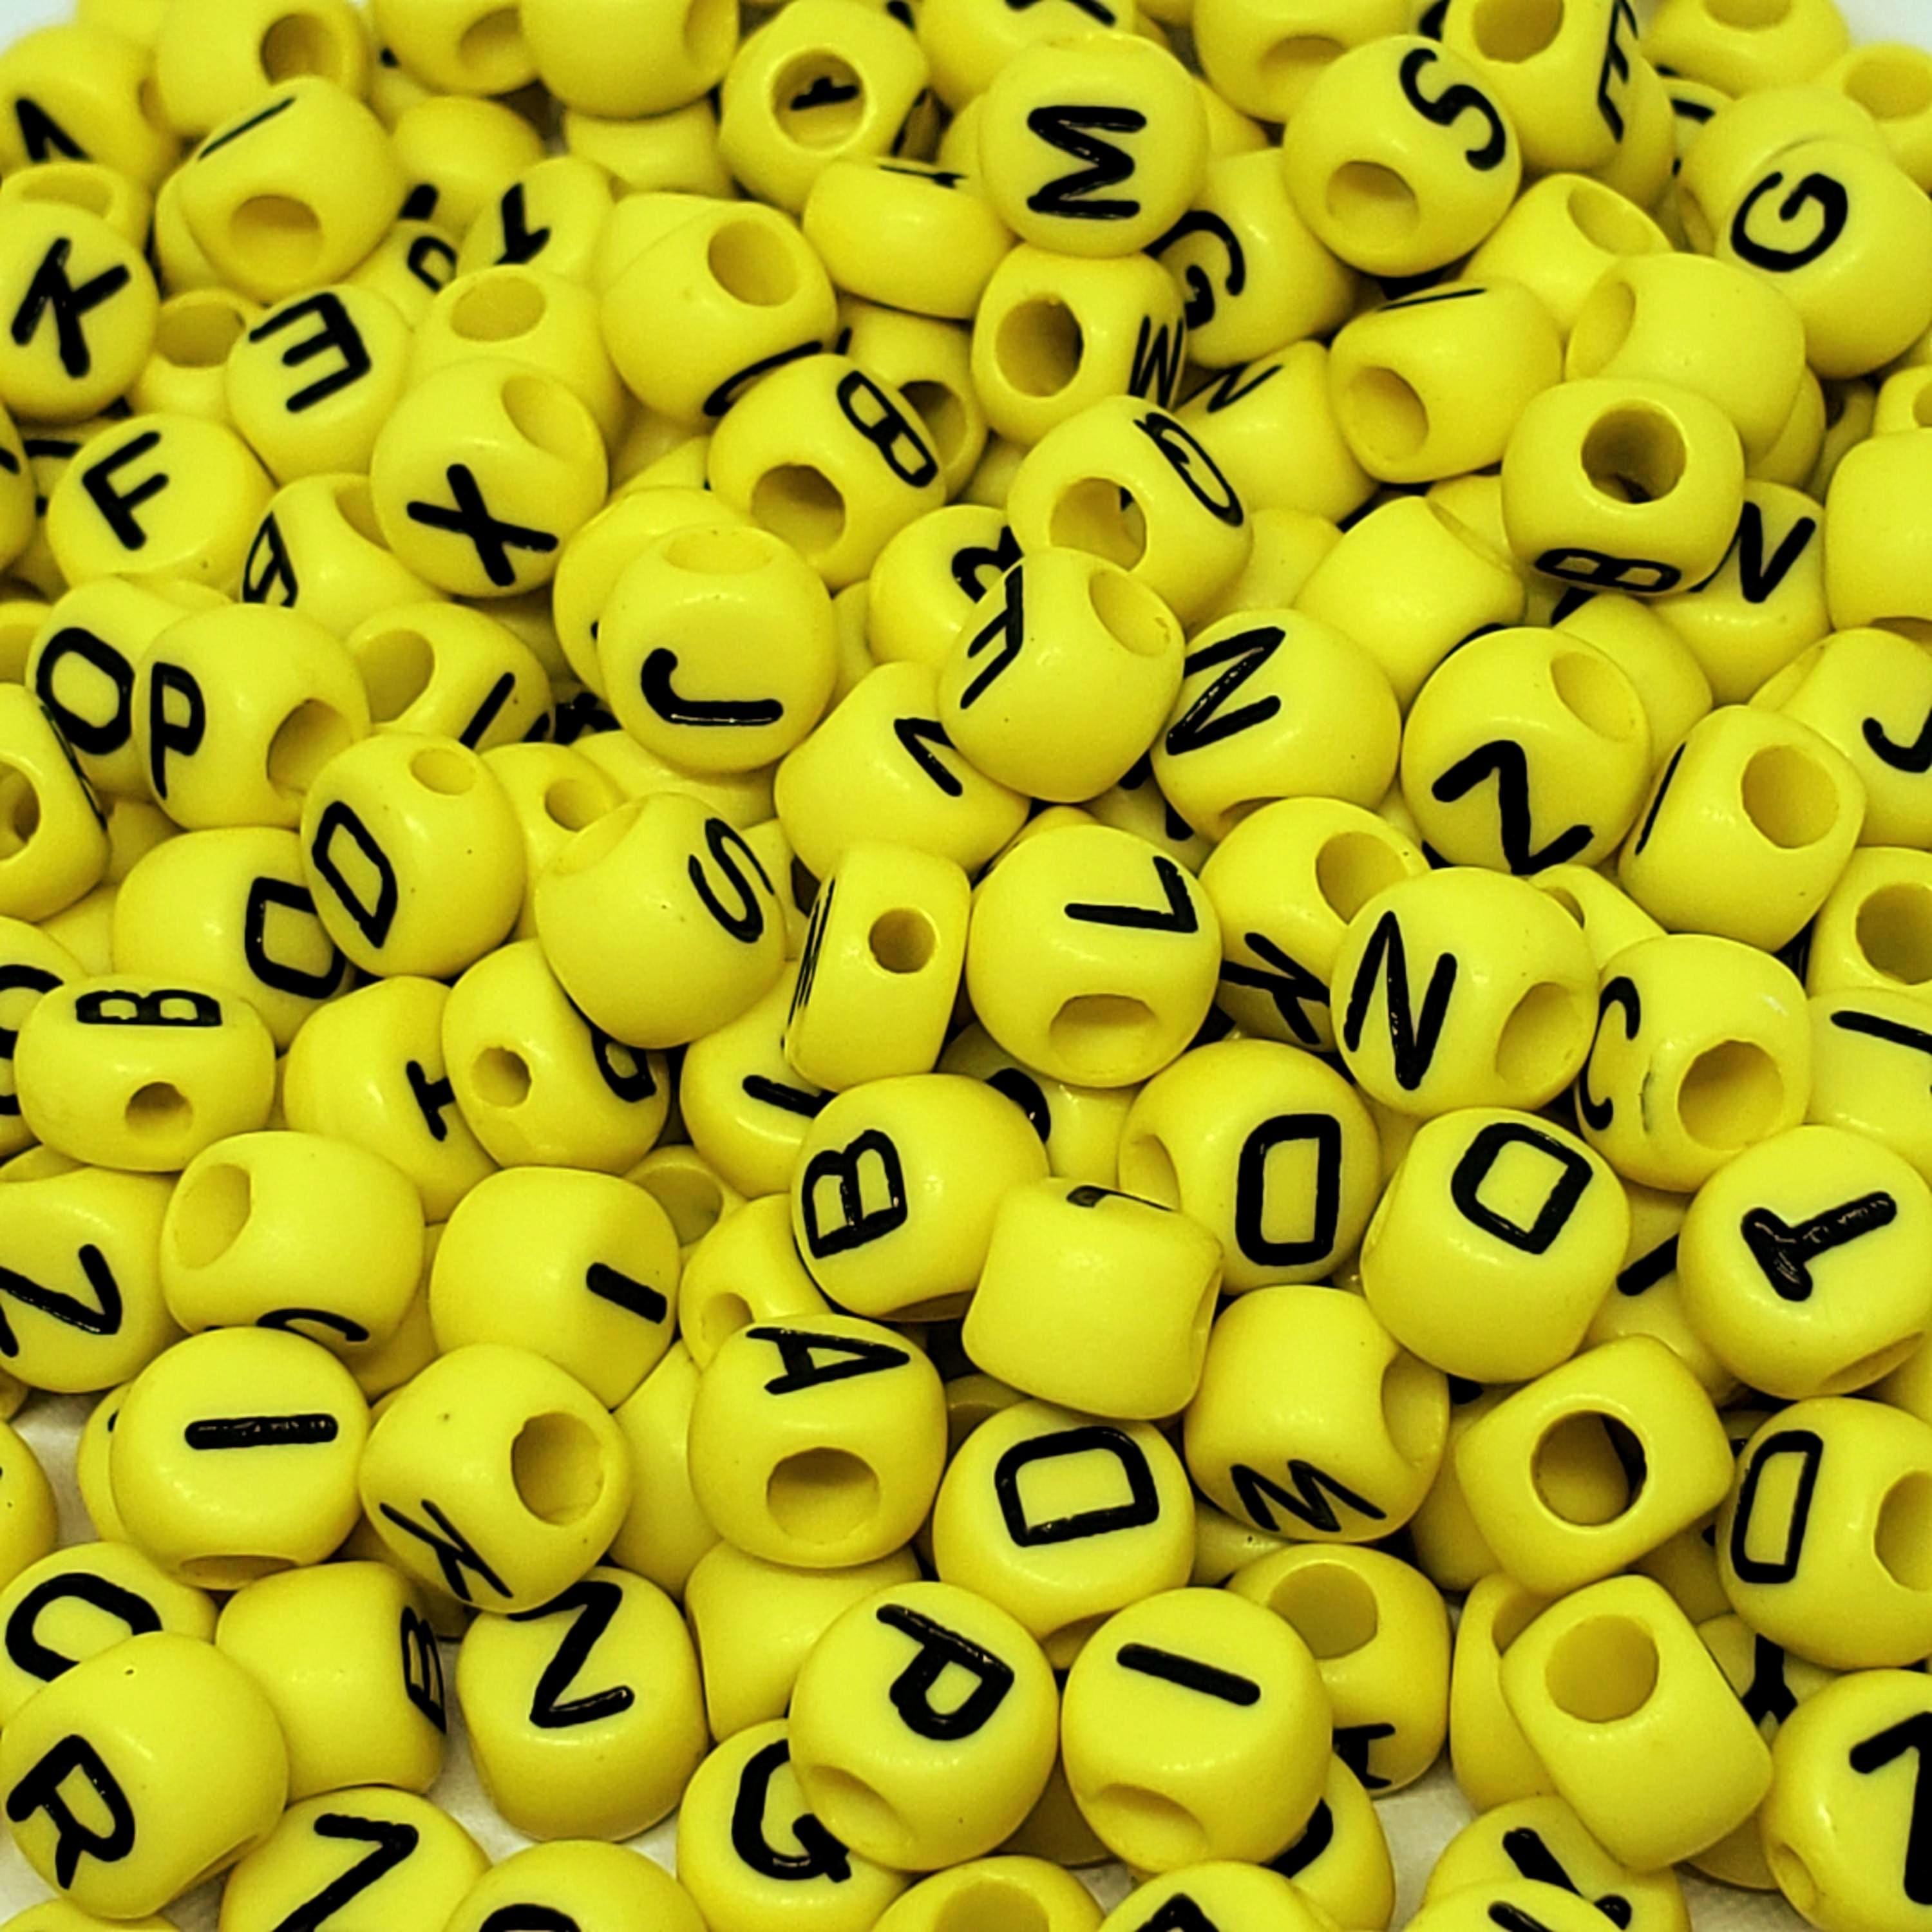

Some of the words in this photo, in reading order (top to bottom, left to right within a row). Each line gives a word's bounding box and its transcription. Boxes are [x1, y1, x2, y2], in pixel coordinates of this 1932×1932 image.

[1027, 106, 1146, 220] M
[1400, 49, 1505, 170] S
[1731, 173, 1848, 272] G
[12, 239, 129, 377] K
[250, 294, 370, 412] E
[837, 371, 938, 488] B
[82, 433, 167, 549] F
[407, 464, 558, 587] X
[1534, 549, 1682, 593] B
[641, 649, 783, 726] J
[960, 567, 1023, 709] F
[150, 662, 205, 799] P
[312, 801, 397, 948] D
[689, 818, 774, 943] S
[1065, 857, 1198, 933] L
[76, 990, 222, 1027] B
[1344, 911, 1457, 1090] N
[802, 1130, 907, 1258] B
[1236, 1114, 1341, 1266] D
[1452, 1123, 1593, 1254] D
[1741, 1192, 1897, 1301] T
[747, 1328, 909, 1394] A
[185, 1414, 337, 1450] I
[996, 1425, 1160, 1548] D
[379, 1500, 513, 1602] K
[1731, 1431, 1824, 1584] D
[400, 1605, 448, 1735] B
[877, 1605, 1014, 1741] P
[1117, 1645, 1260, 1705] I
[6, 1735, 135, 1889] R
